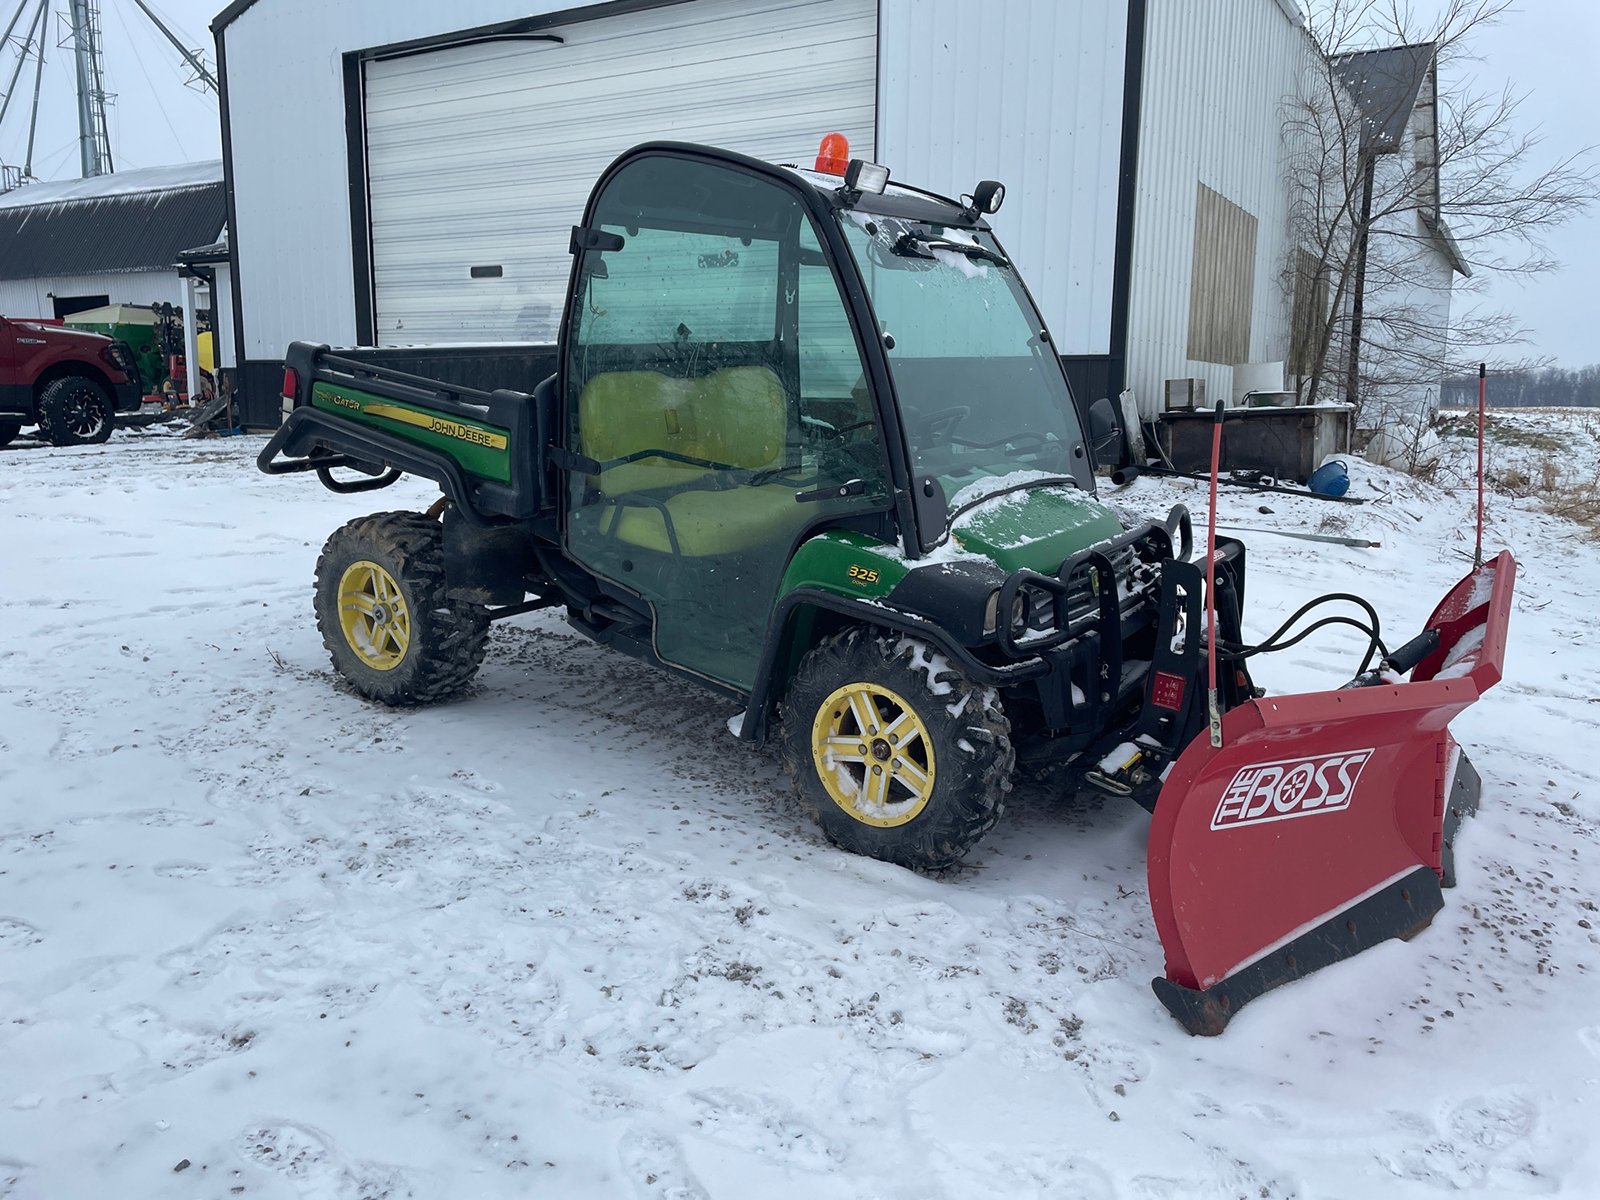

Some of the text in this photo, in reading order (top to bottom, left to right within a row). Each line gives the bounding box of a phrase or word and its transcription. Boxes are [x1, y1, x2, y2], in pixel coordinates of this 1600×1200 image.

[333, 395, 360, 410] GATOR
[429, 418, 491, 446] JOHN DEERE
[1217, 754, 1367, 823] THE BOSS
